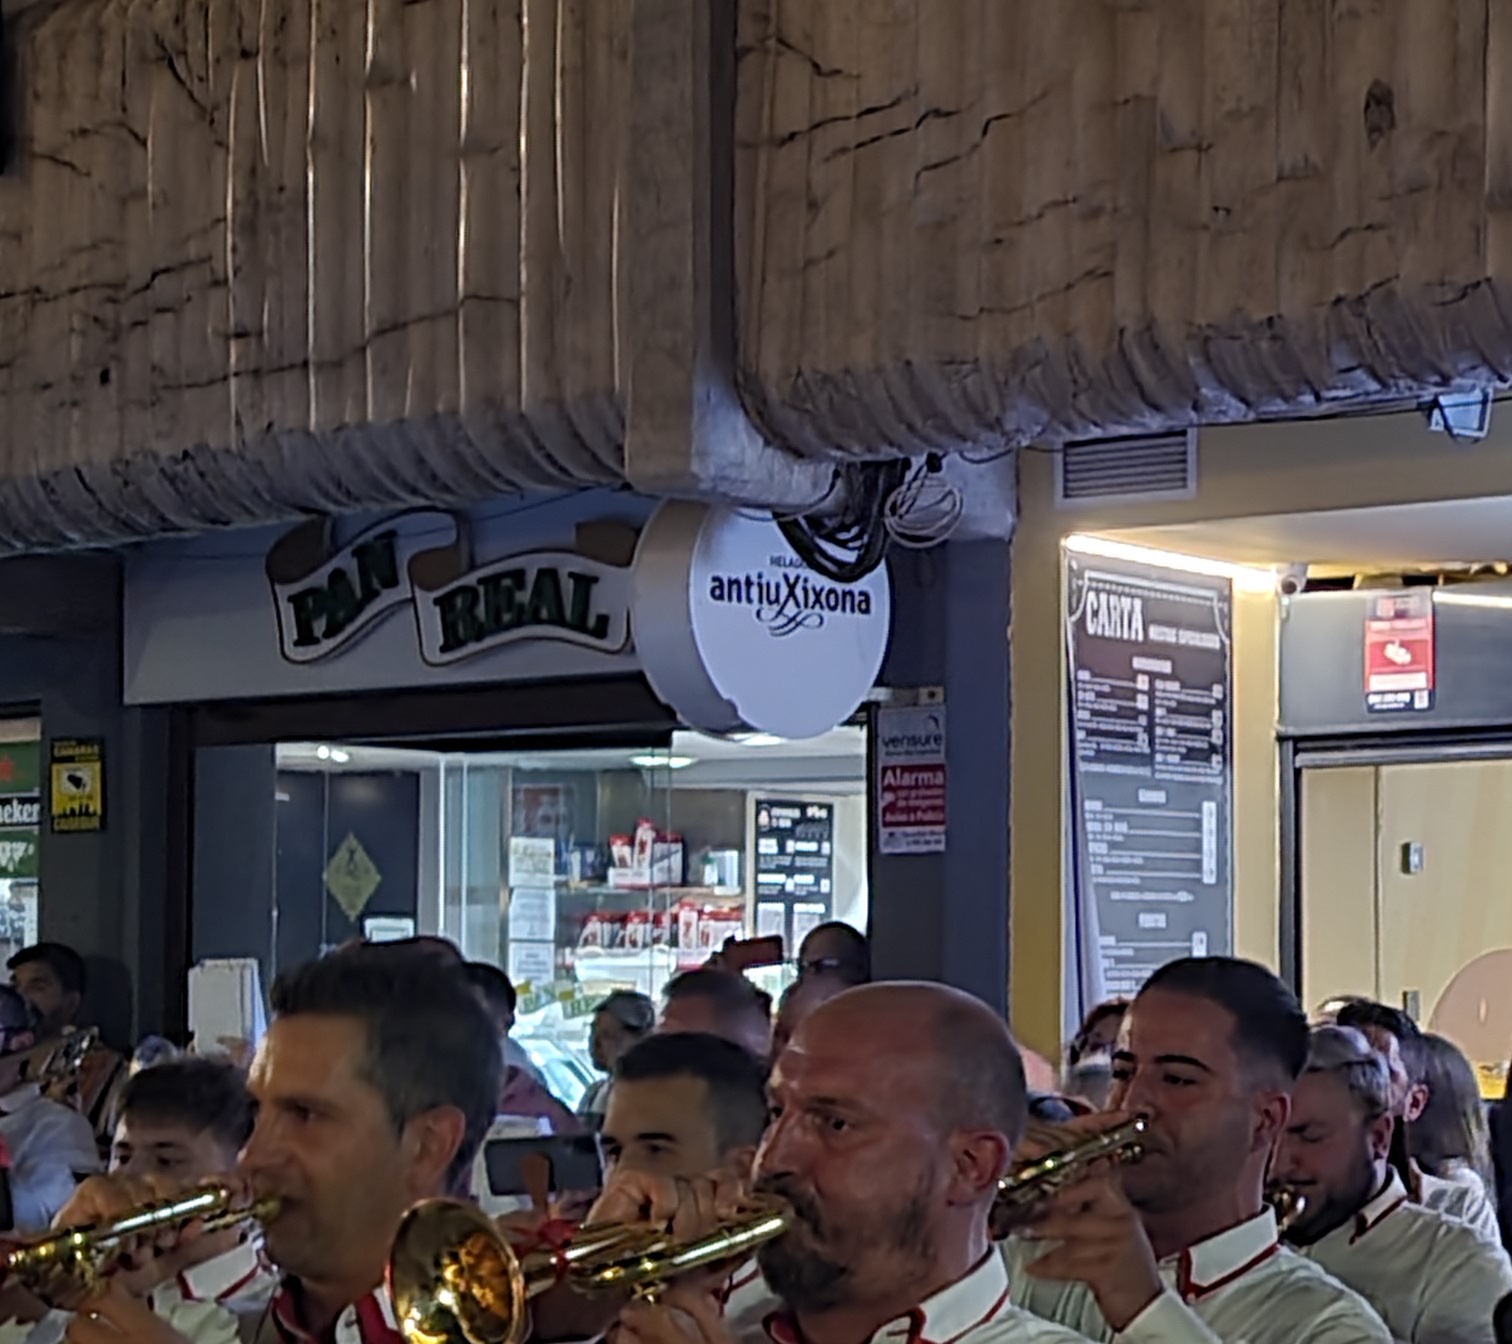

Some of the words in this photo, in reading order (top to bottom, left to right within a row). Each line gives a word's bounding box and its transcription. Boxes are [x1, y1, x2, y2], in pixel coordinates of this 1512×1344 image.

[287, 530, 399, 646] PAN
[432, 568, 609, 654] REAL
[1086, 591, 1144, 642] CARTA
[884, 767, 943, 786] Alarma
